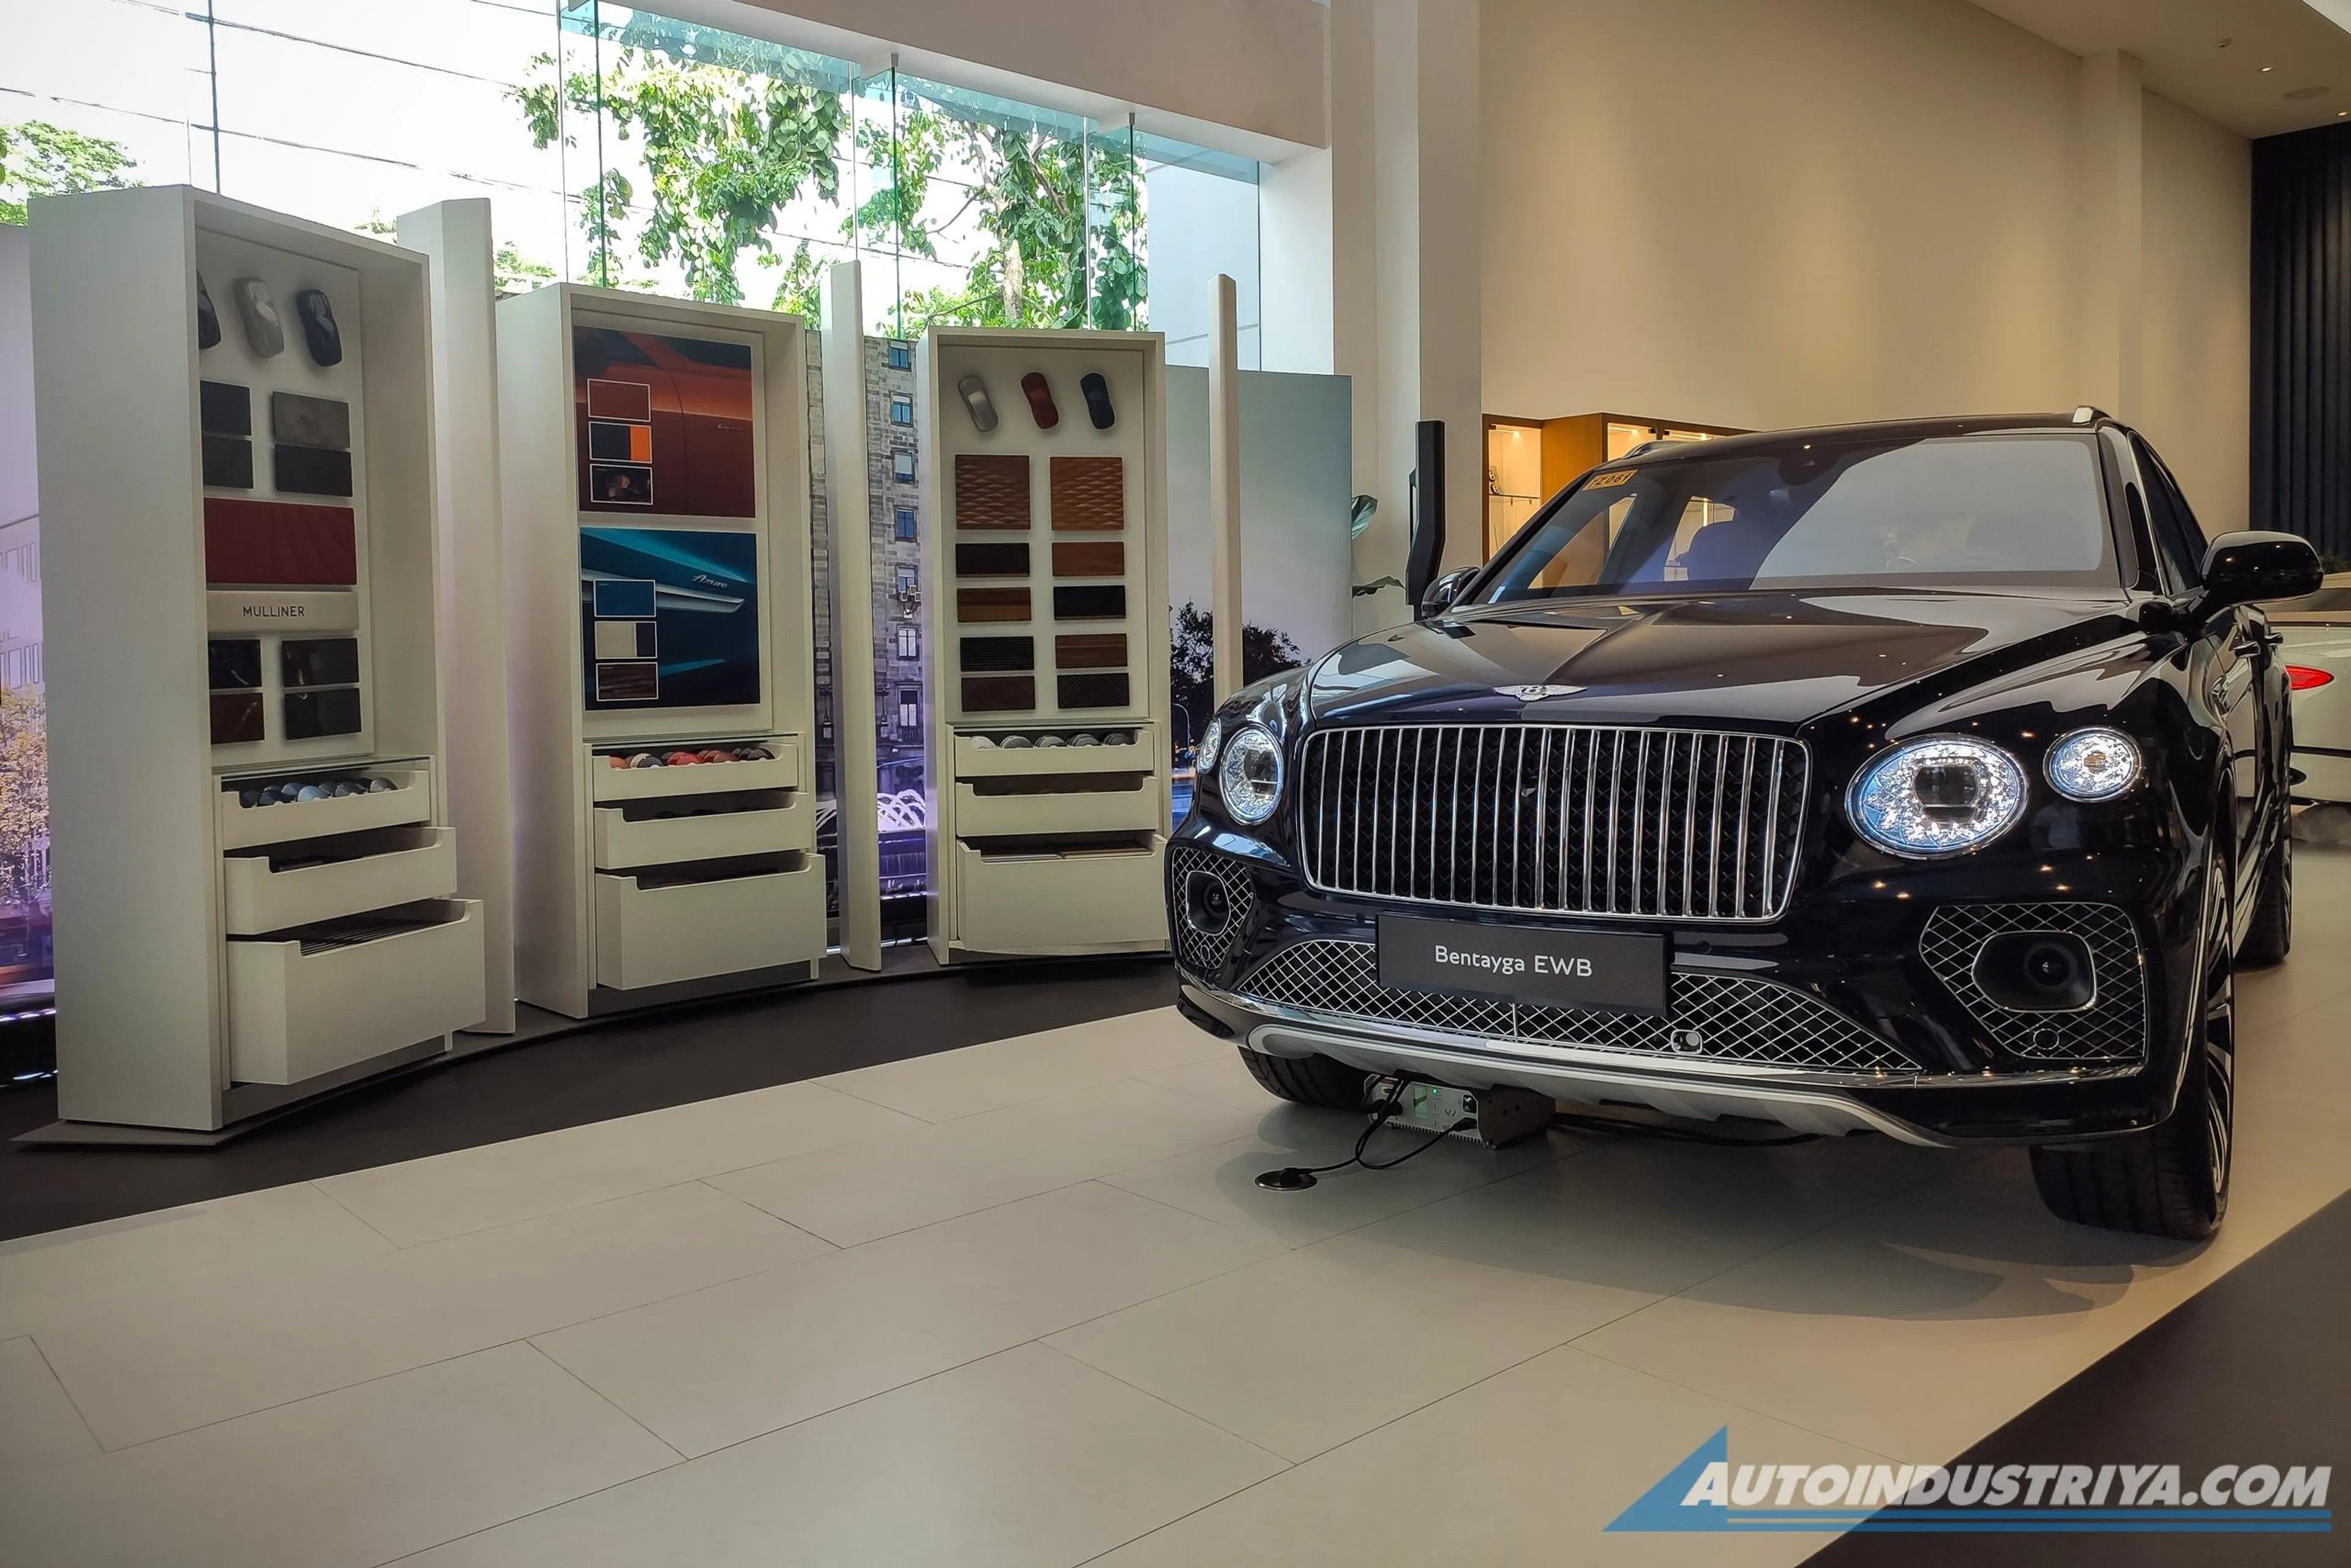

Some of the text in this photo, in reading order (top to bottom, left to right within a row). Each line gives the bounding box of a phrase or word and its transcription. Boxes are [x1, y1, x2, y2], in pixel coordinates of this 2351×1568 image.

[691, 574, 727, 588] Azure
[243, 605, 305, 617] MULLINER
[1435, 945, 1592, 977] Bentayga EWB
